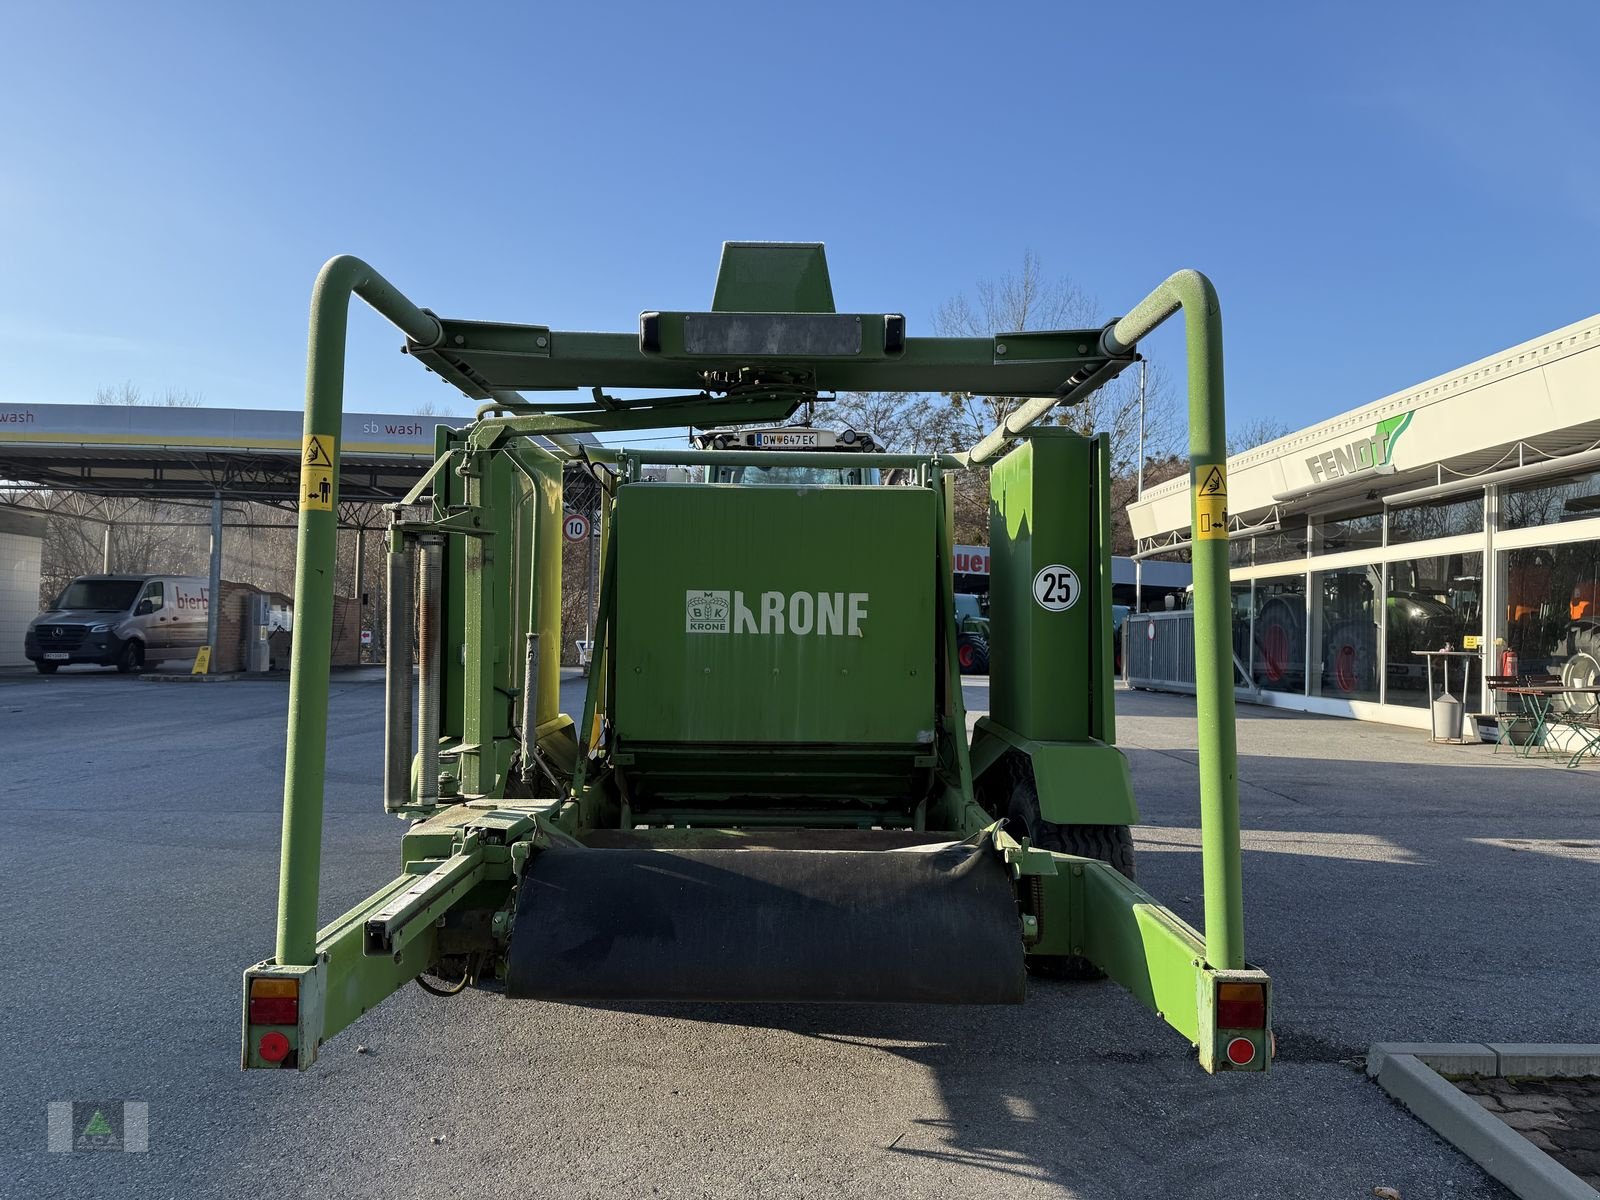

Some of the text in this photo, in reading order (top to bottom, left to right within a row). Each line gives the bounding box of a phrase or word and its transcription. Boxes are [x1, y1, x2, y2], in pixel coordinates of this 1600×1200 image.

[0, 410, 34, 423] wash
[363, 420, 423, 435] sb wash
[1305, 431, 1389, 484] FENDT
[569, 522, 583, 535] 10
[953, 553, 990, 573] uer
[1042, 572, 1071, 603] 25
[175, 585, 209, 610] bierb
[690, 623, 726, 631] KRONE
